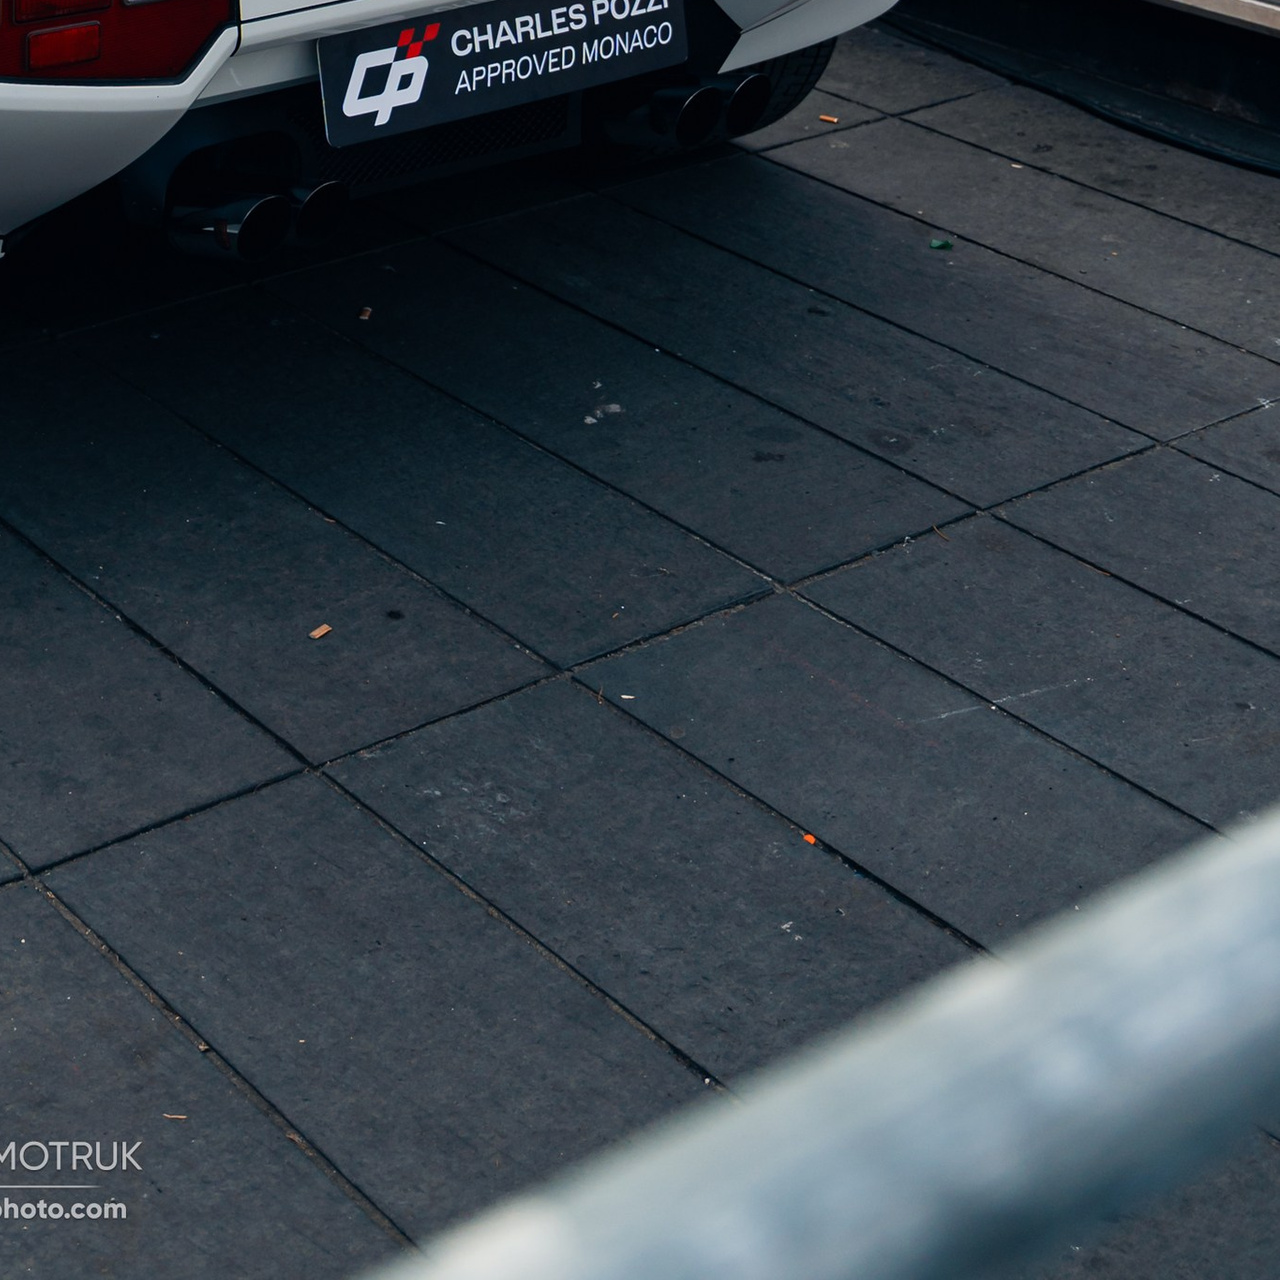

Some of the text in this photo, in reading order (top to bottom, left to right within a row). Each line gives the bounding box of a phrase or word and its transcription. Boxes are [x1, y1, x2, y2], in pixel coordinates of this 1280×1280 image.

[450, 3, 587, 57] CHARLES
[454, 22, 673, 95] APPROVED MONACO
